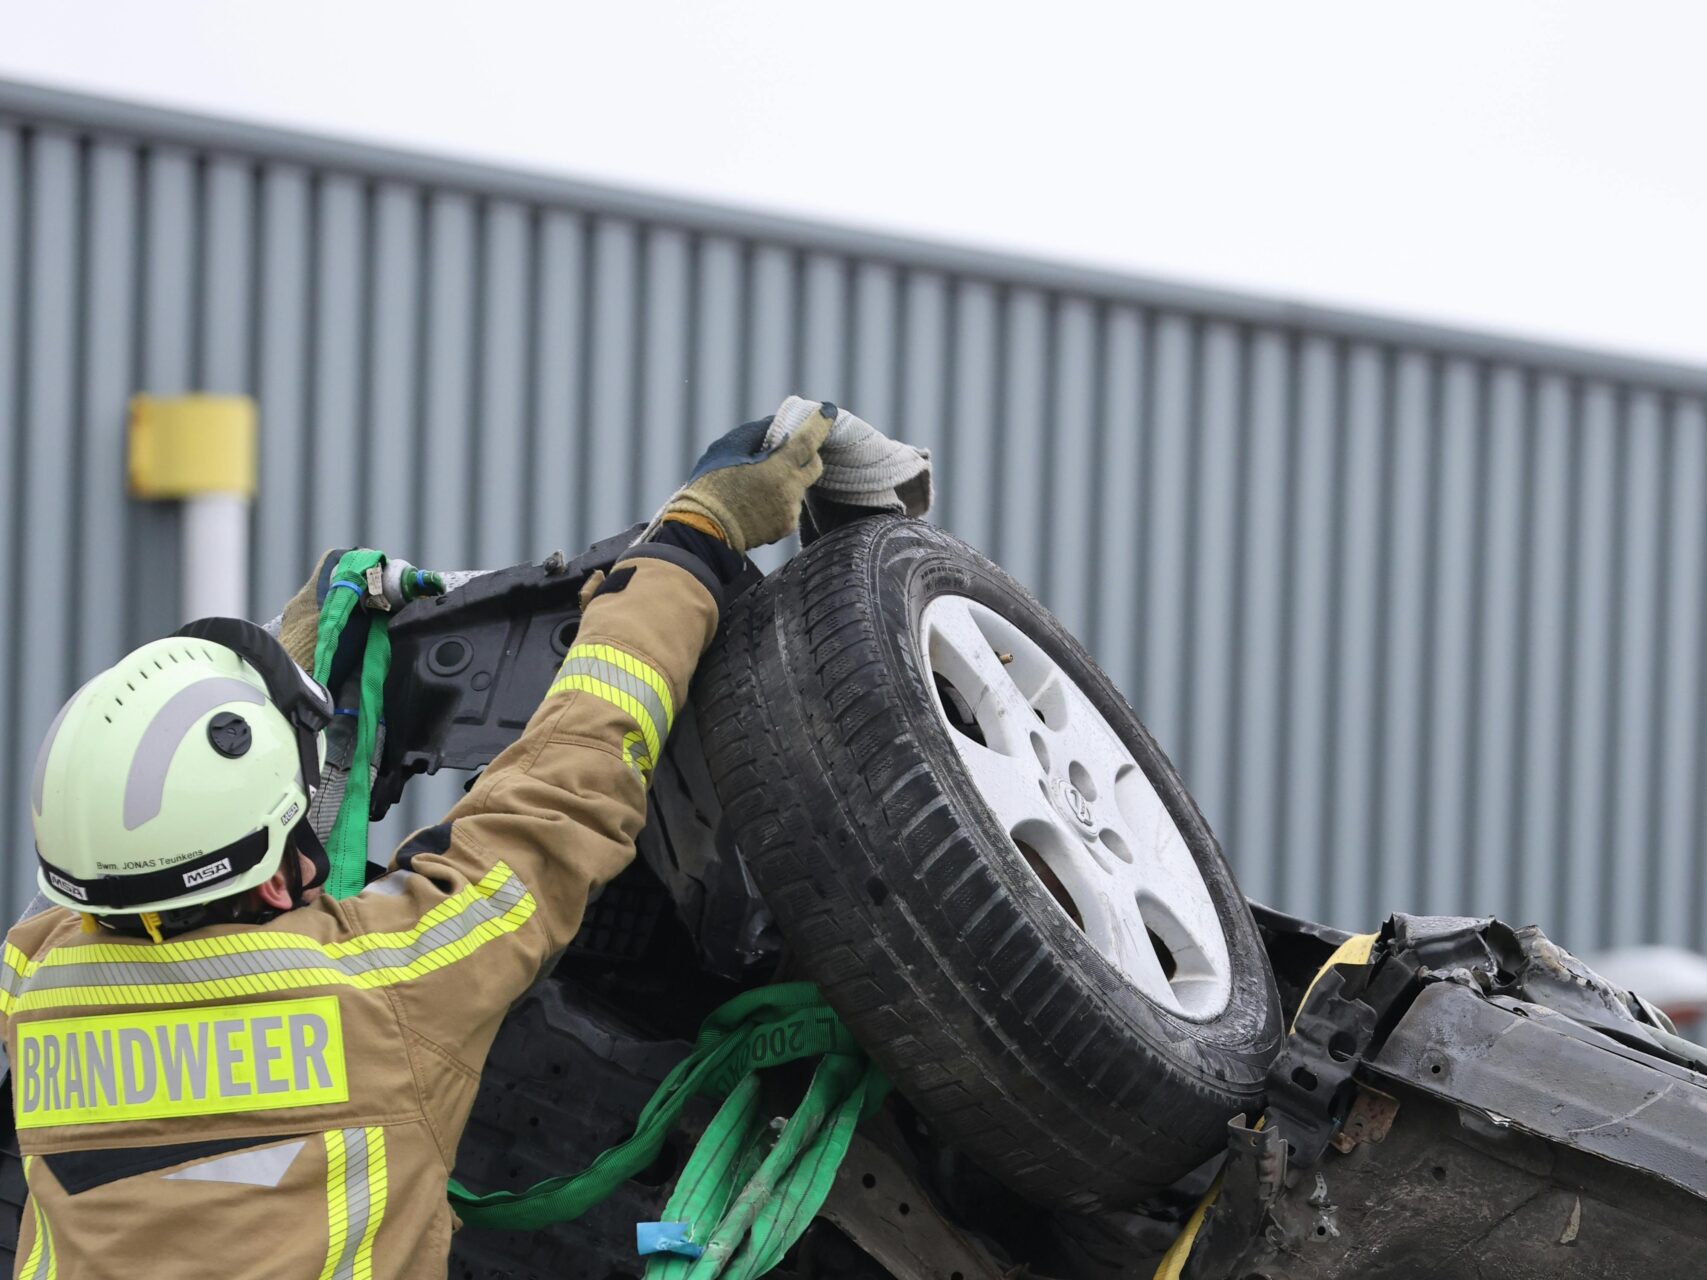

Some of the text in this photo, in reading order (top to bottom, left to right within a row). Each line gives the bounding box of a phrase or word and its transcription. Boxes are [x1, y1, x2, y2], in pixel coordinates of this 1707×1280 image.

[281, 801, 299, 826] MSA
[122, 860, 156, 871] JONAS
[159, 849, 204, 866] Teunkens
[185, 863, 228, 884] MSA
[51, 875, 84, 898] MSA
[23, 1013, 333, 1113] BRANDWEER
